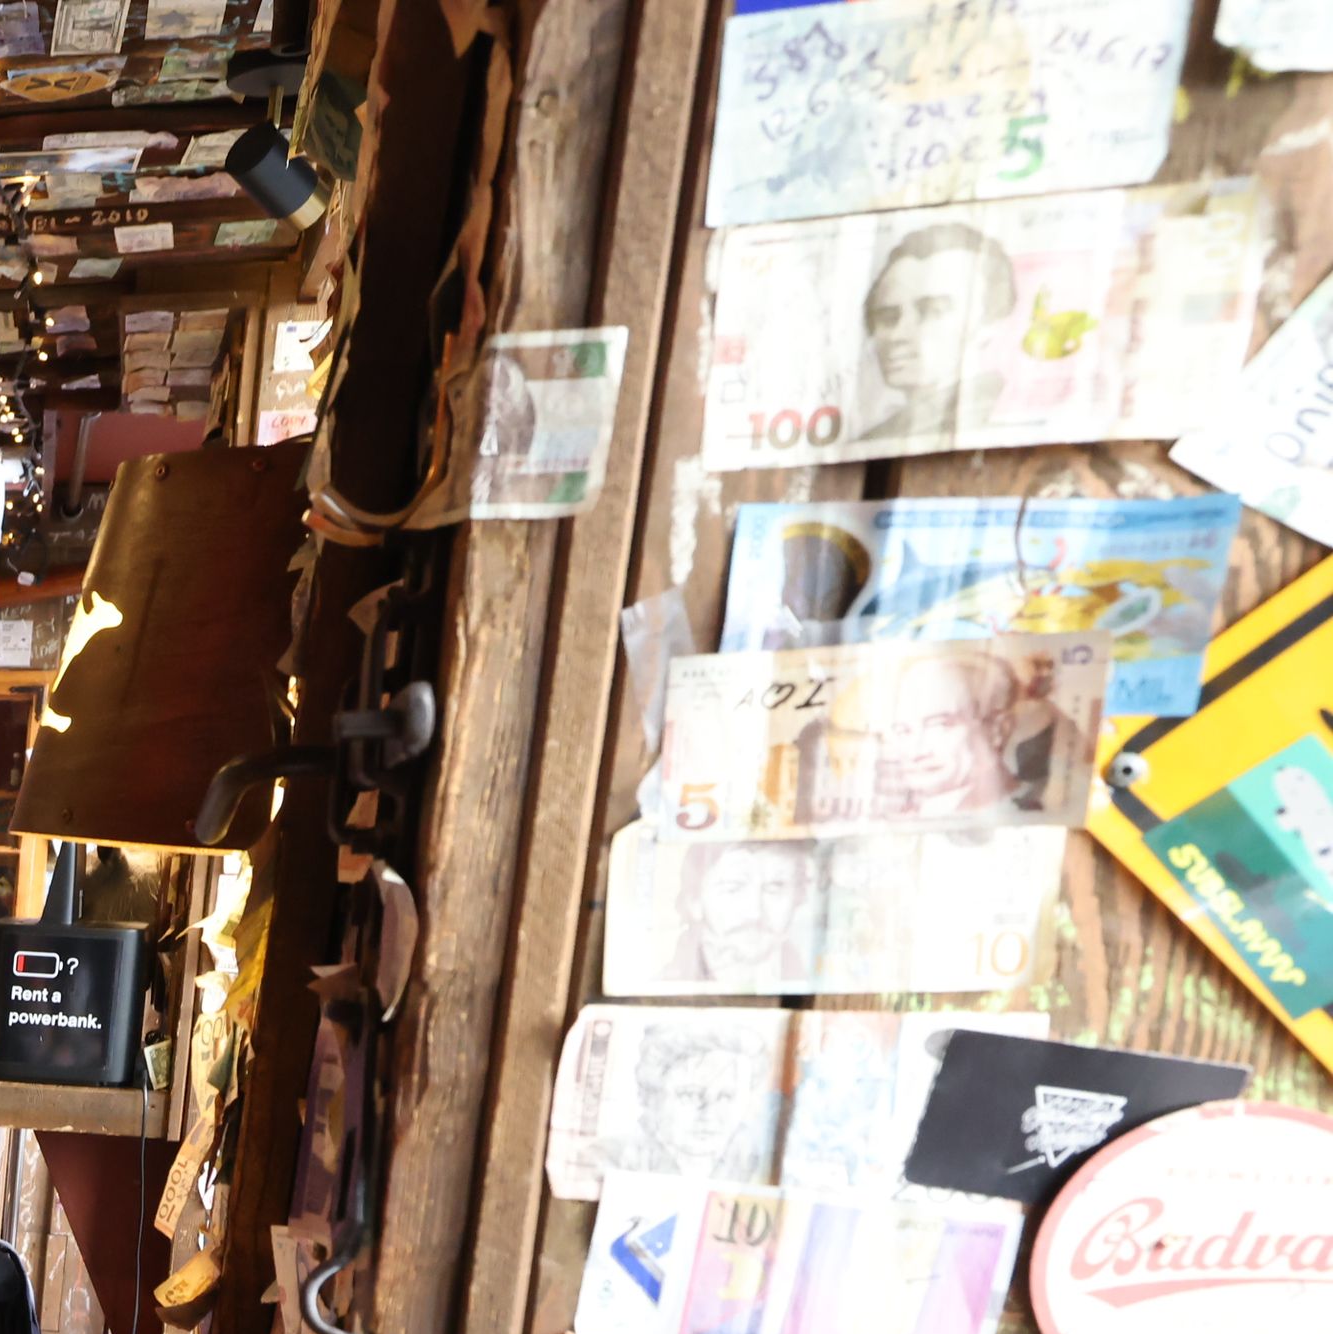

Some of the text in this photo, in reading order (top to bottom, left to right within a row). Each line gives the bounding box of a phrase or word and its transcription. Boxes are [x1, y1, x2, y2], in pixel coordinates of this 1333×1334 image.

[998, 114, 1049, 181] 5
[748, 406, 843, 451] 100
[674, 783, 720, 831] 5
[969, 932, 1029, 976] 10
[11, 985, 62, 1003] Rent a
[8, 1011, 102, 1030] powerbank.
[714, 1200, 773, 1247] 10
[1070, 1197, 1333, 1281] Budva
